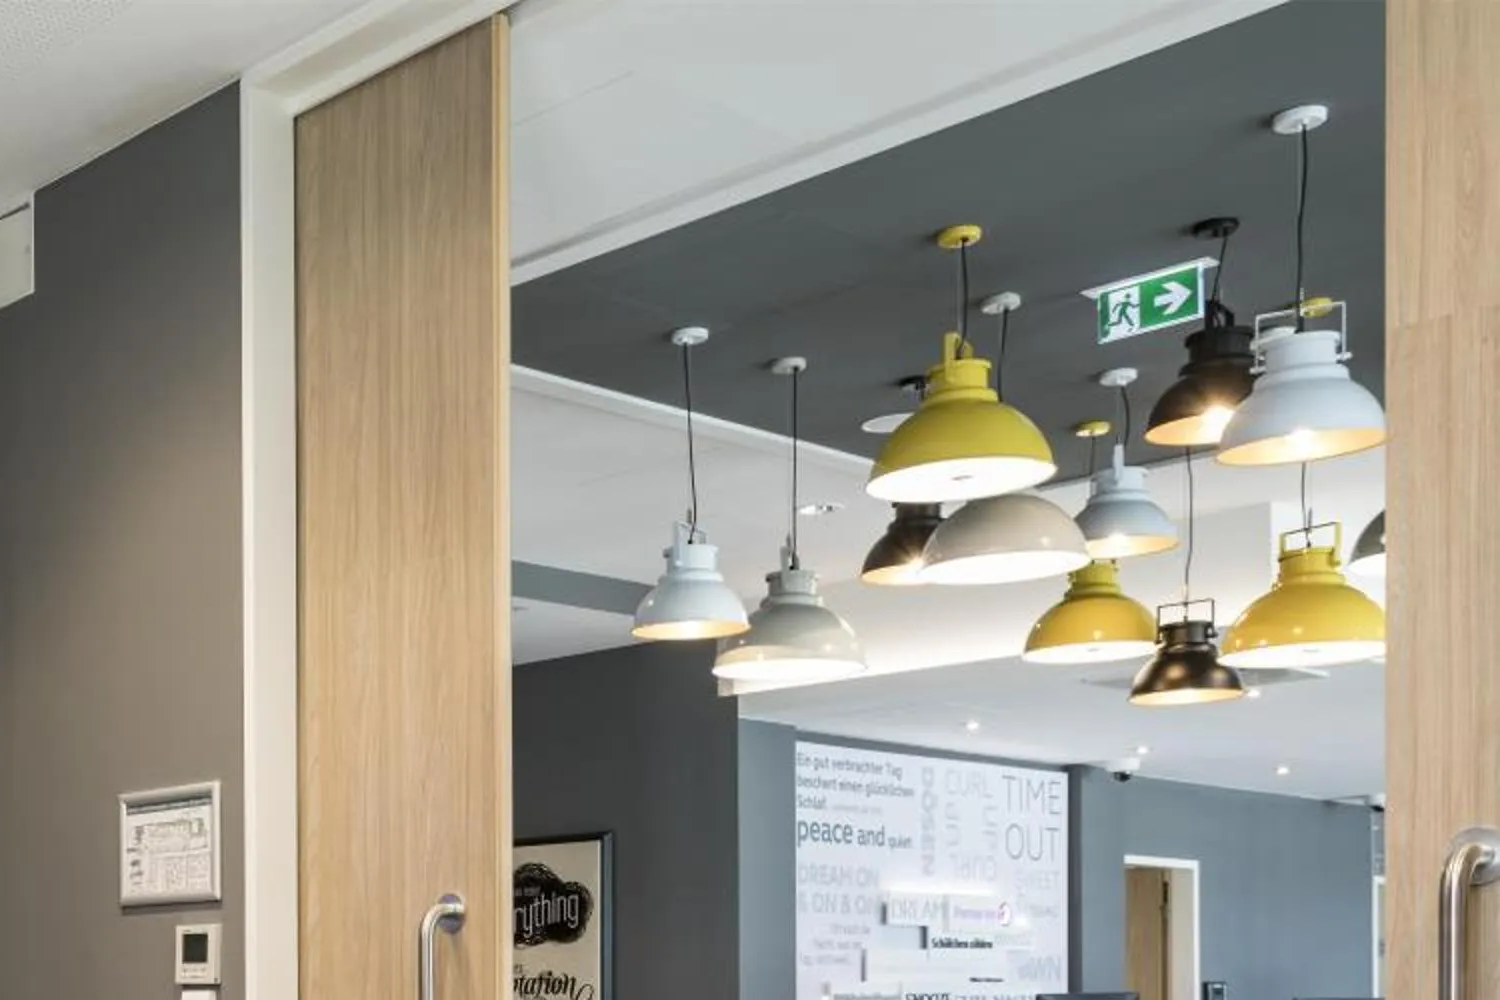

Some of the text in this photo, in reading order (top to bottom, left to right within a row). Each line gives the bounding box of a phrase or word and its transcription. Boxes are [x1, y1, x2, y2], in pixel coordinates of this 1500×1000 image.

[1001, 774, 1062, 816] TIME
[797, 819, 853, 848] peace
[857, 823, 885, 847] and
[1005, 823, 1060, 862] OUT
[513, 892, 579, 938] rything
